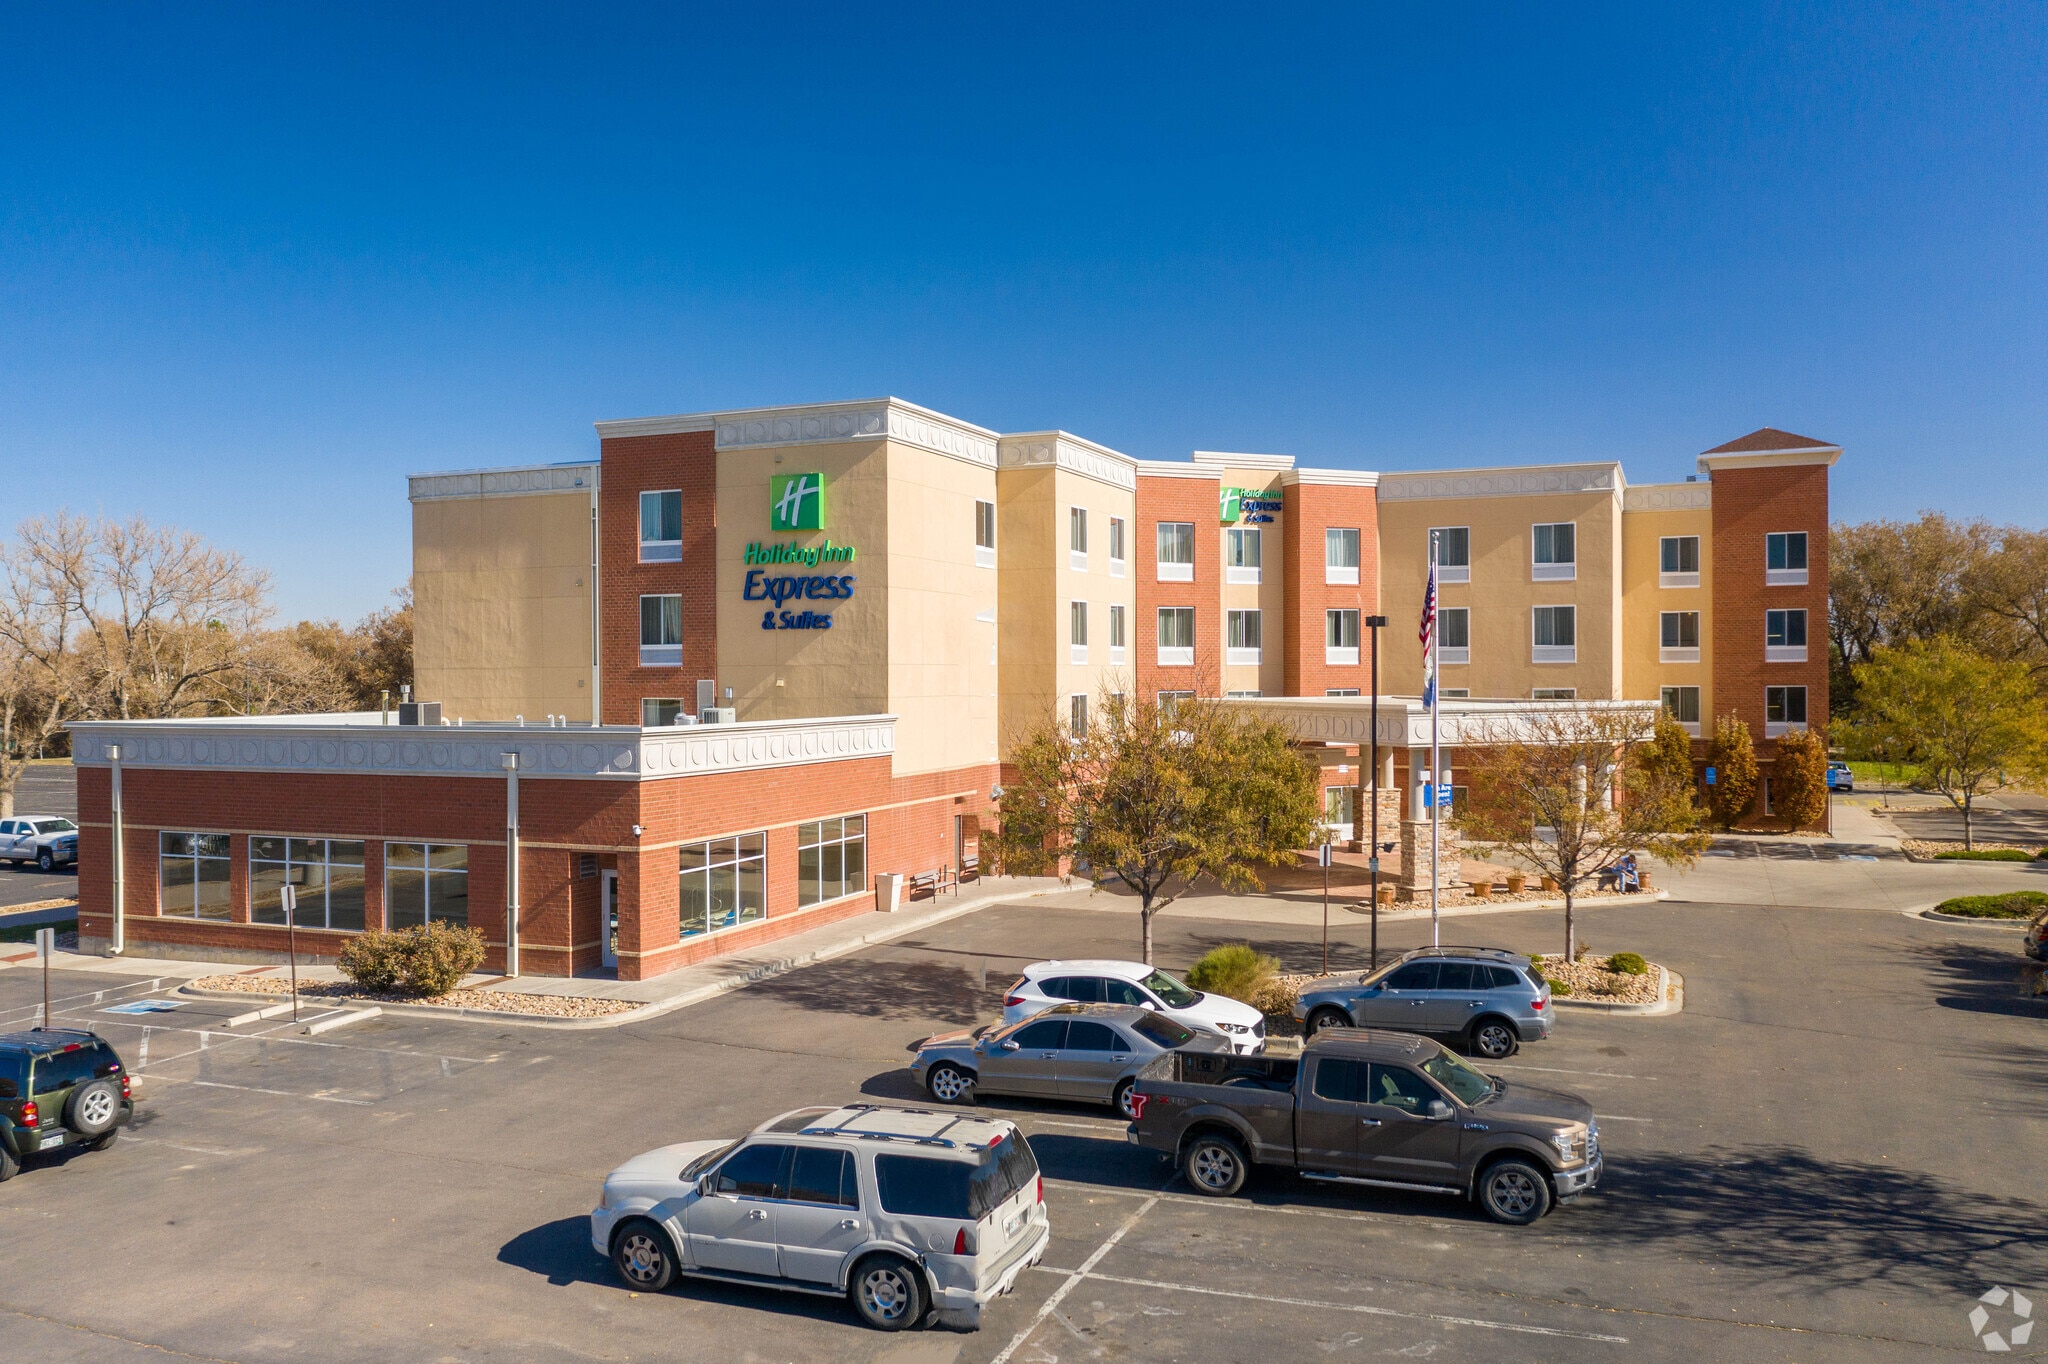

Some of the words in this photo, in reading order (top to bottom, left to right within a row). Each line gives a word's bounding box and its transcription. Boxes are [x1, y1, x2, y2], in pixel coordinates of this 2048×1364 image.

[1240, 488, 1269, 499] Holiday
[1240, 498, 1282, 512] Express
[744, 541, 820, 568] Holiday
[822, 540, 856, 562] Inn
[743, 570, 855, 608] Express
[762, 611, 776, 630] &
[778, 611, 833, 630] Suites
